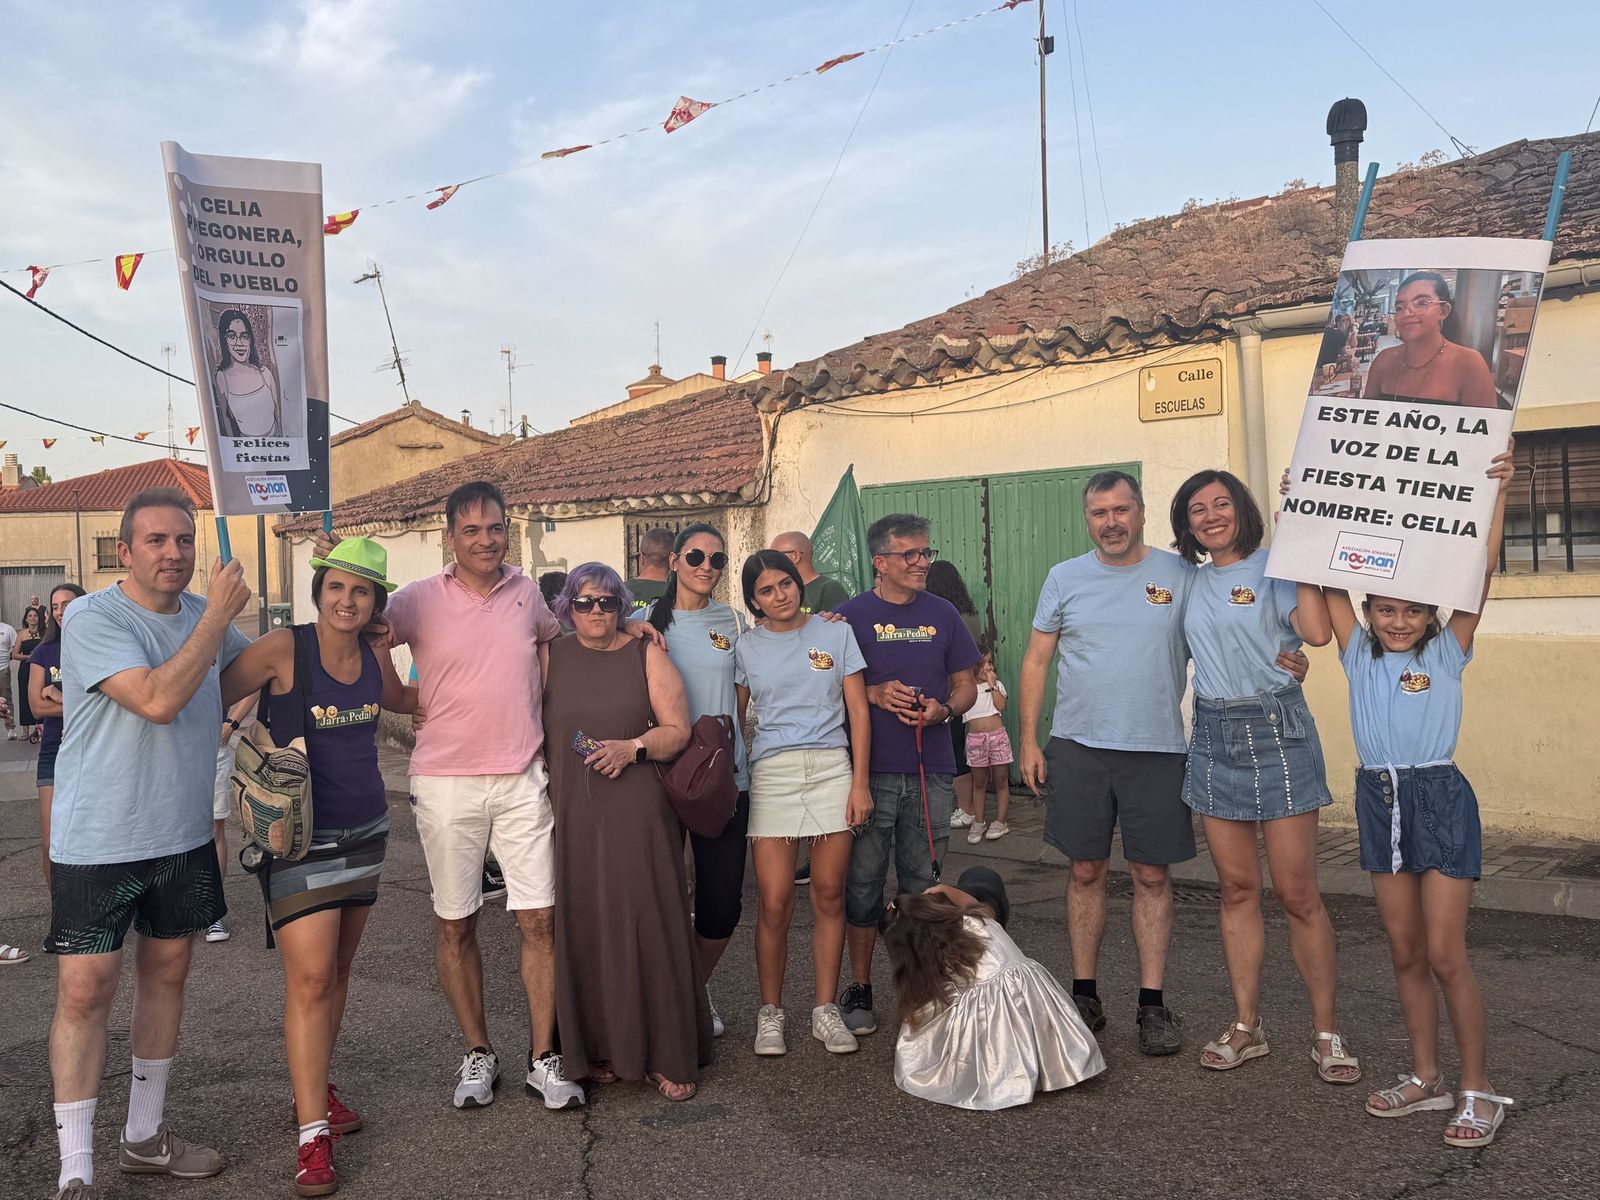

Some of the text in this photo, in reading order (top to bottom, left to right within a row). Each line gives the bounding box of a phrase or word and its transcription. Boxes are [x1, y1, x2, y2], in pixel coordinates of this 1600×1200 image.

[200, 197, 262, 217] CELIA
[187, 213, 302, 248] PREGONERA,
[197, 243, 286, 268] ORGULLO
[193, 265, 298, 293] DEL PUEBLO
[1178, 369, 1214, 382] Calle
[1155, 397, 1206, 414] ESCUELAS
[1317, 406, 1489, 435] ESTE AÑO, LA
[232, 438, 290, 447] Felices
[1330, 439, 1459, 466] VOZ DE LA
[235, 453, 290, 462] fiestas
[248, 482, 287, 494] noonan
[1301, 467, 1474, 503] FIESTA TIENE
[1282, 498, 1478, 538] NOMBRE: CELIA
[1338, 551, 1394, 568] noonan
